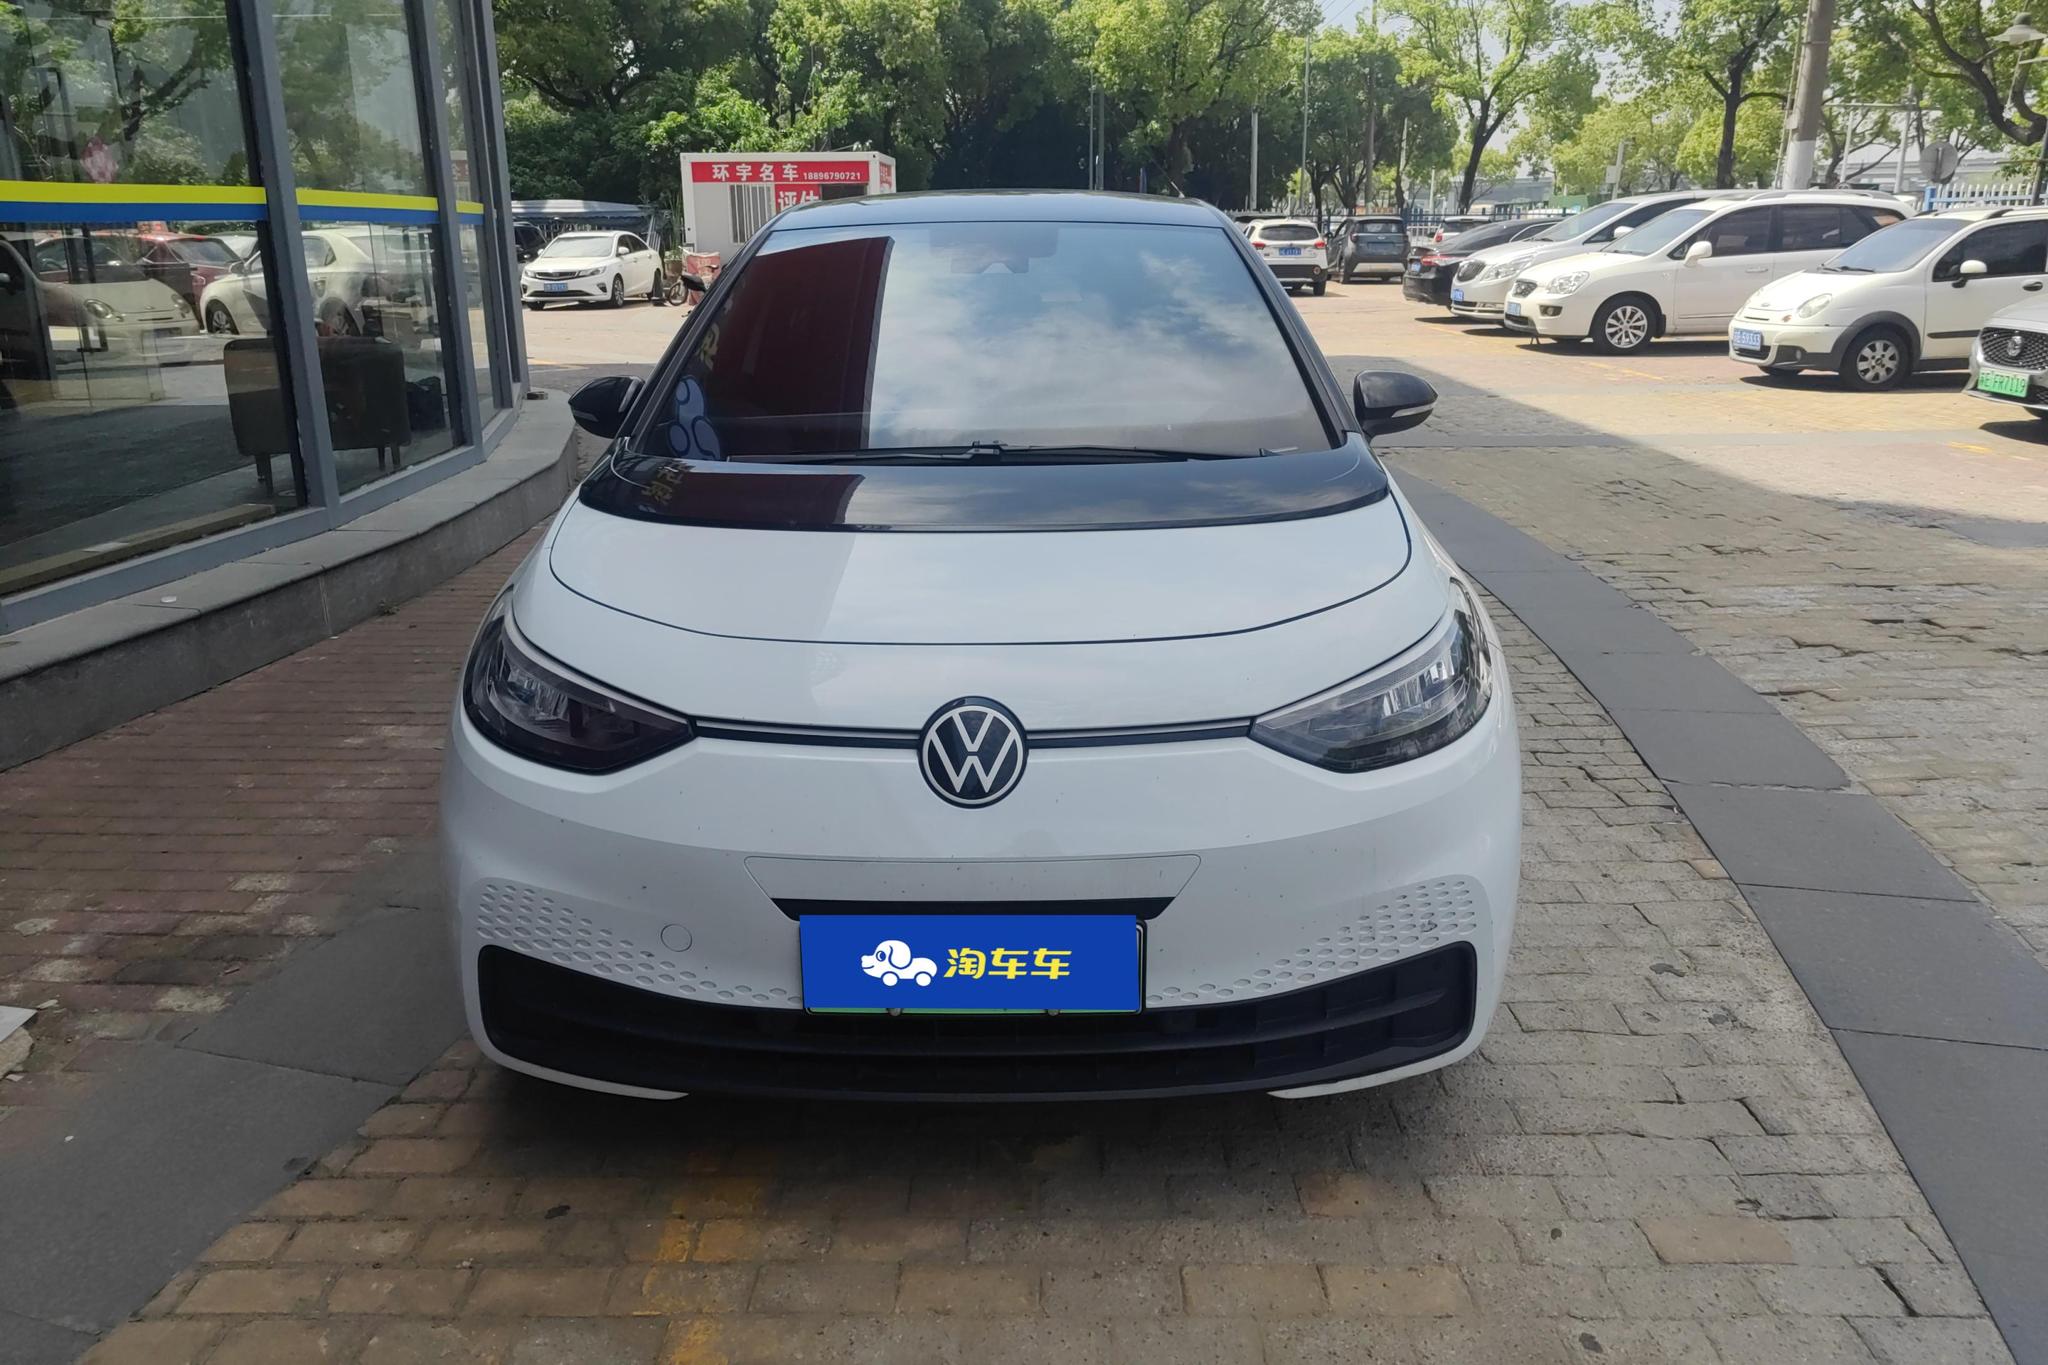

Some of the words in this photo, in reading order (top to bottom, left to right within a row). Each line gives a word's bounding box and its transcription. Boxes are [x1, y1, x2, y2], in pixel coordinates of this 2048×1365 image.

[711, 164, 799, 182] 环宇名车
[803, 172, 861, 180] 18896790721
[924, 707, 1021, 803] VW
